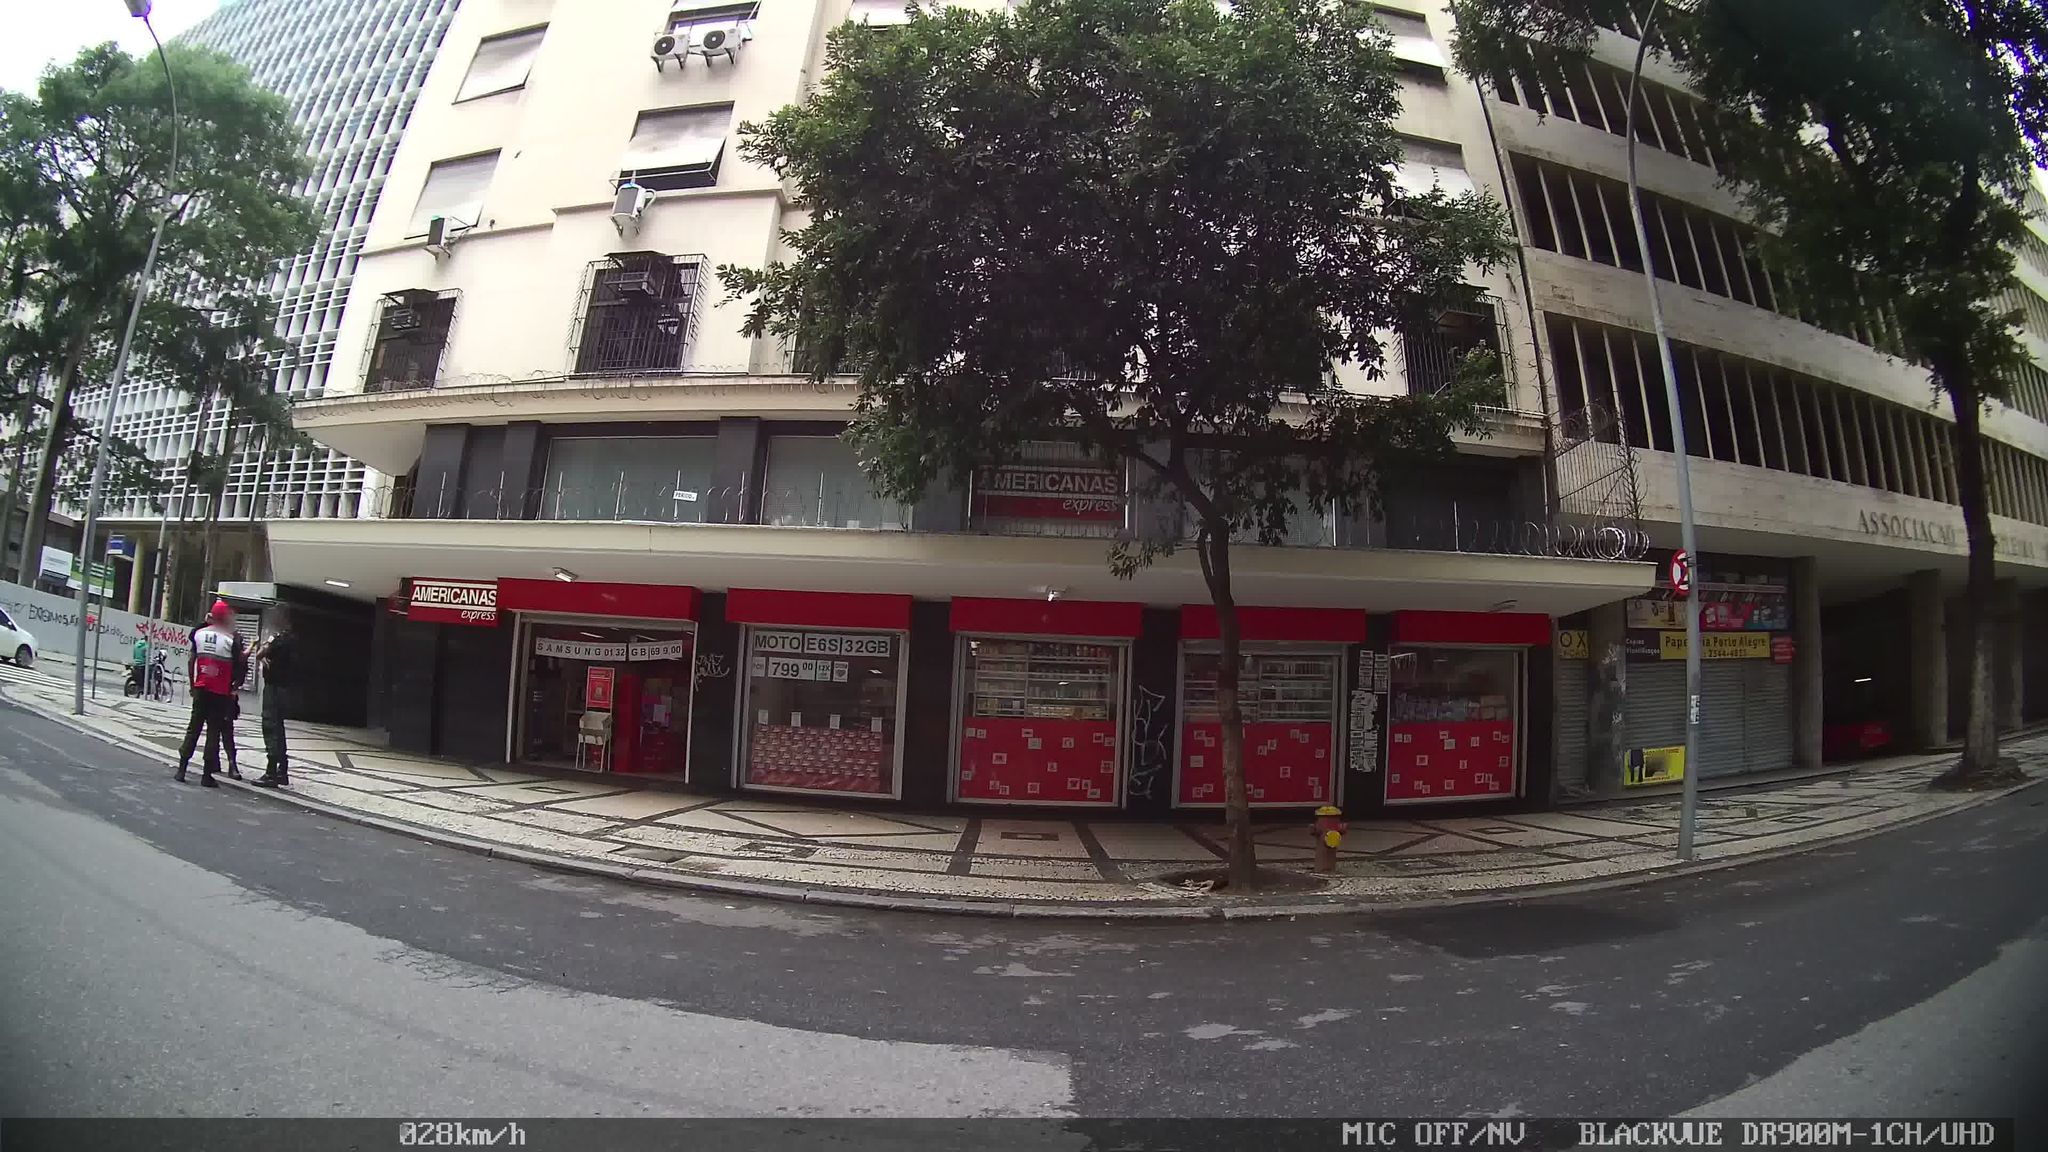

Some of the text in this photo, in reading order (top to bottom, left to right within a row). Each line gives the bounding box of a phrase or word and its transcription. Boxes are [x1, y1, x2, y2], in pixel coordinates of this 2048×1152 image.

[1063, 499, 1118, 515] express
[411, 586, 497, 606] AMERICANAS
[461, 610, 496, 622] express
[537, 641, 601, 657] SAMSUNG
[631, 648, 647, 657] GB
[754, 635, 889, 654] MOTO E6S 32GB
[1713, 636, 1737, 647] Porto
[1739, 636, 1766, 649] Alegre
[772, 662, 800, 678] 799
[802, 662, 813, 671] 00
